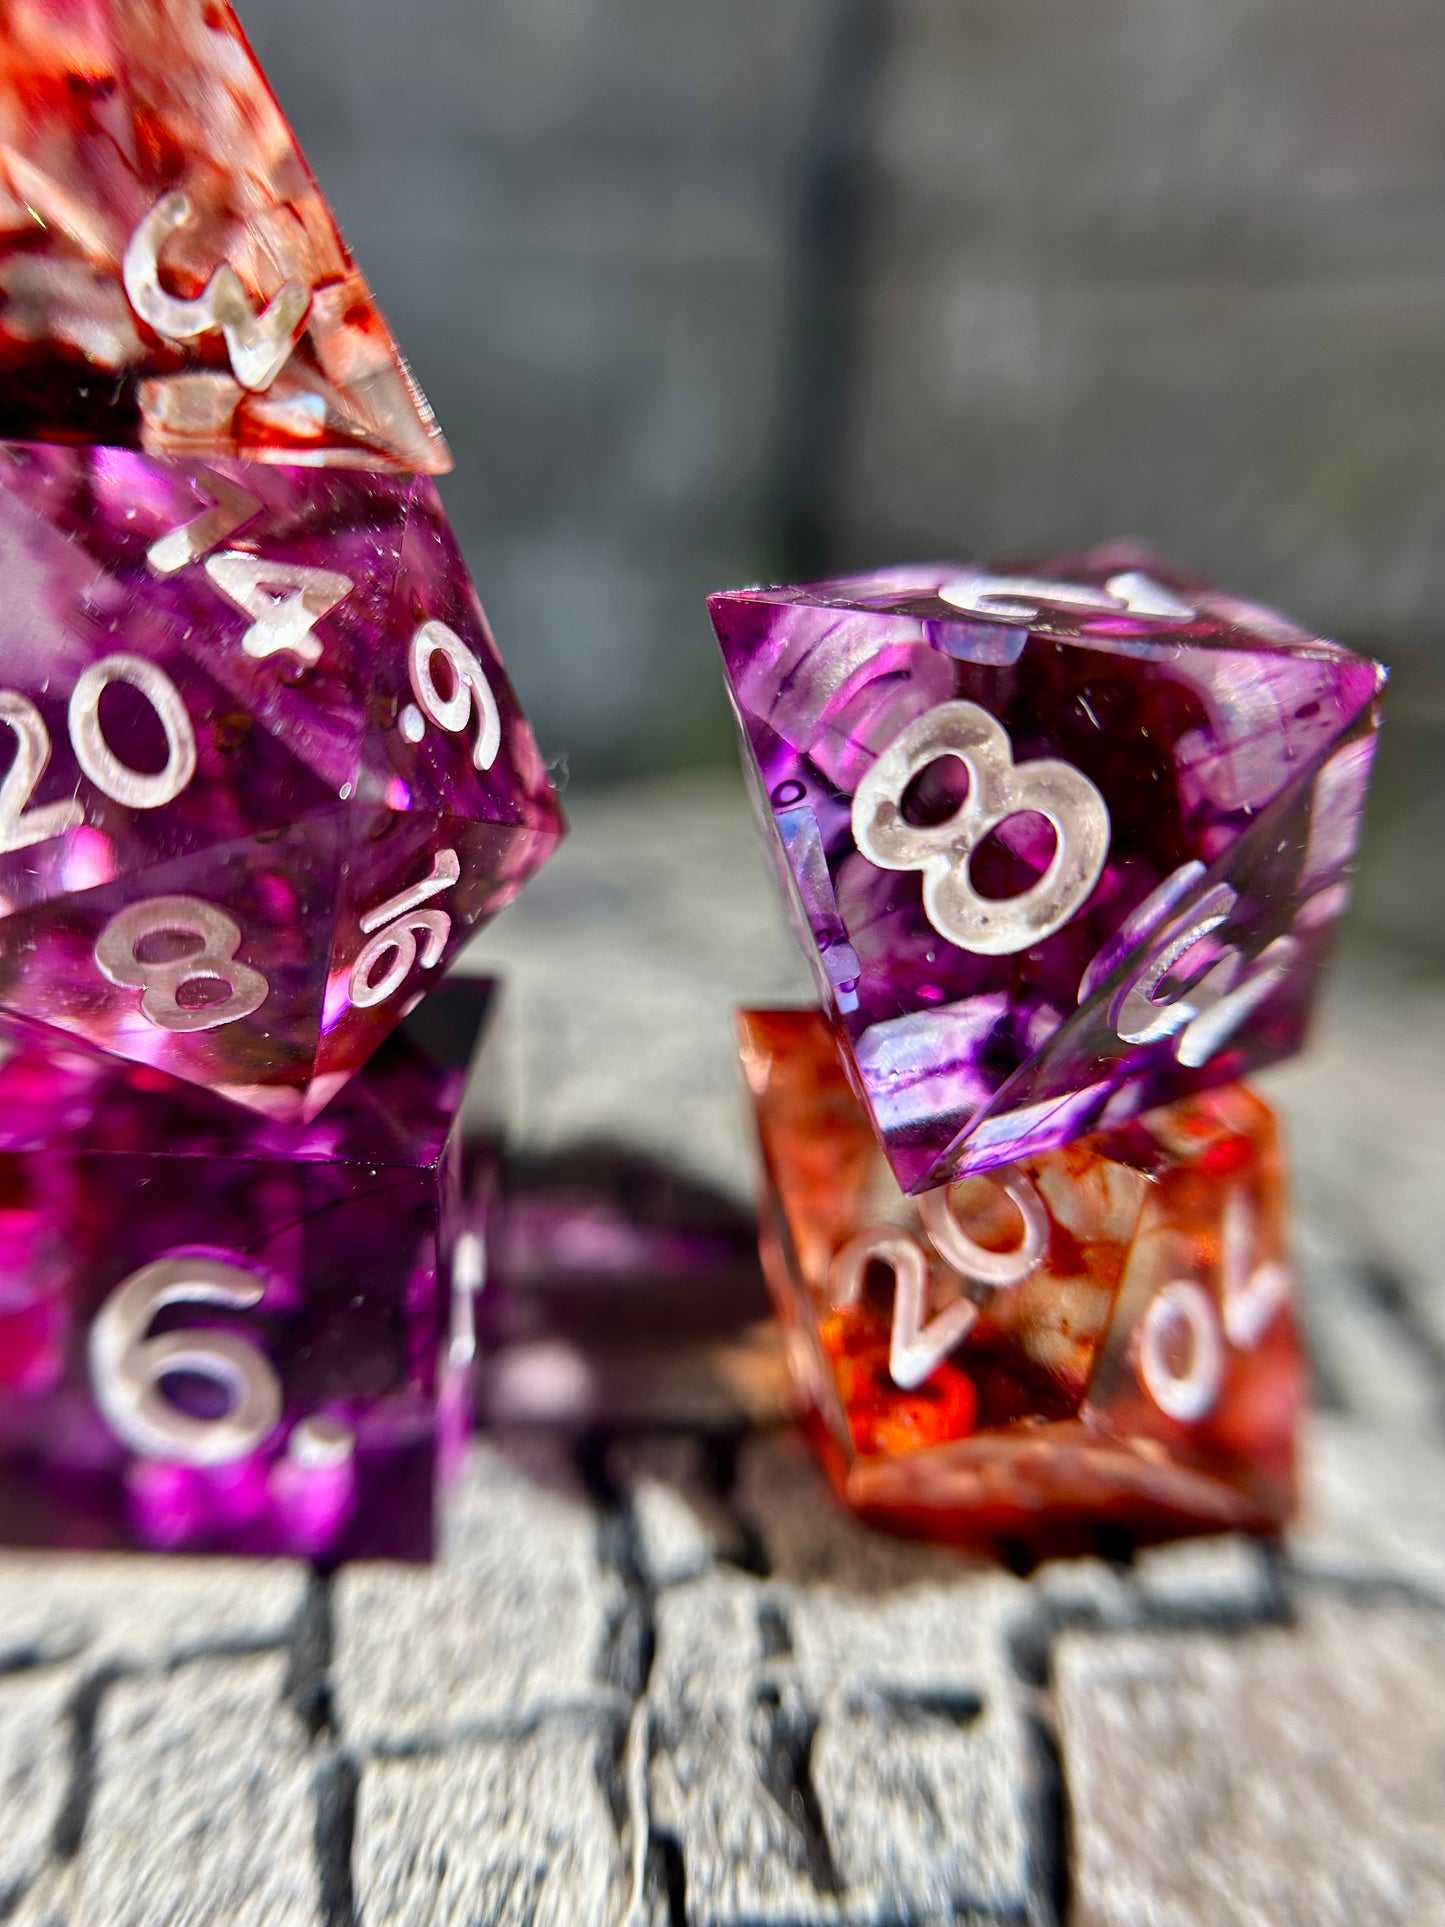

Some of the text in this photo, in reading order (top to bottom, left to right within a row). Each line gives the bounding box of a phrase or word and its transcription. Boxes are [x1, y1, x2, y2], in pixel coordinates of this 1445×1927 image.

[0, 652, 197, 853] 20
[850, 700, 1111, 957] 8
[94, 895, 270, 1033] 8
[348, 848, 461, 1009] 16
[828, 1164, 1053, 1391] 20
